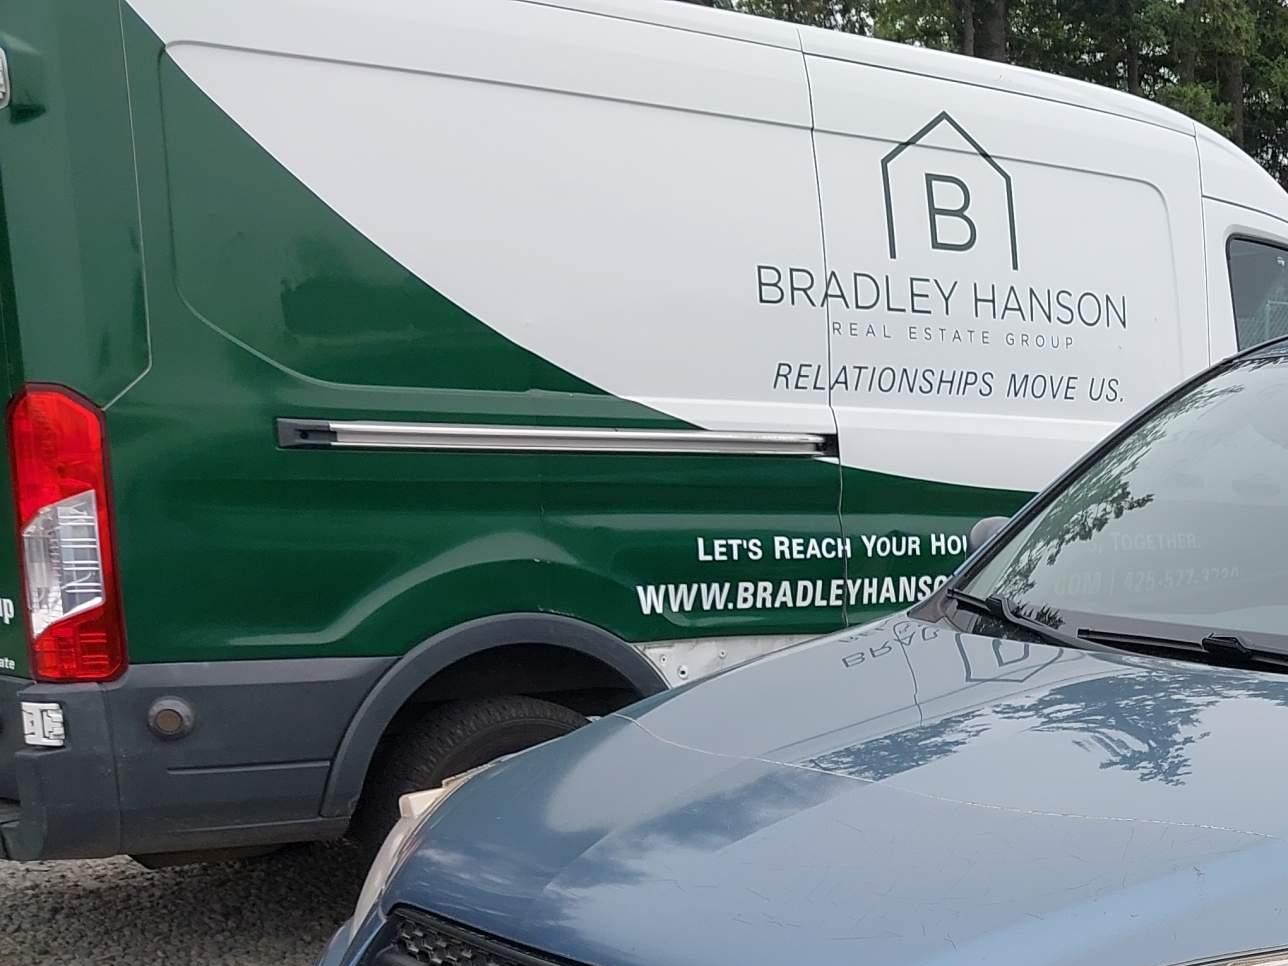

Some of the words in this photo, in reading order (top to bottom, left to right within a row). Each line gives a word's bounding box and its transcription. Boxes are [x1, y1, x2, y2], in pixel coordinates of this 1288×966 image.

[925, 172, 978, 252] B
[756, 265, 958, 316] BRADLEY
[973, 281, 1128, 329] HANSON
[832, 321, 892, 339] REAL
[908, 326, 991, 345] ESTATE
[1005, 333, 1075, 350] GROUP
[773, 363, 995, 398] RELATIONSHIPS
[1006, 373, 1078, 401] MOVE
[1088, 378, 1125, 403] US.
[697, 537, 763, 561] LET'S
[774, 536, 851, 560] REACH
[861, 535, 921, 557] YOUR
[931, 533, 967, 555] HO
